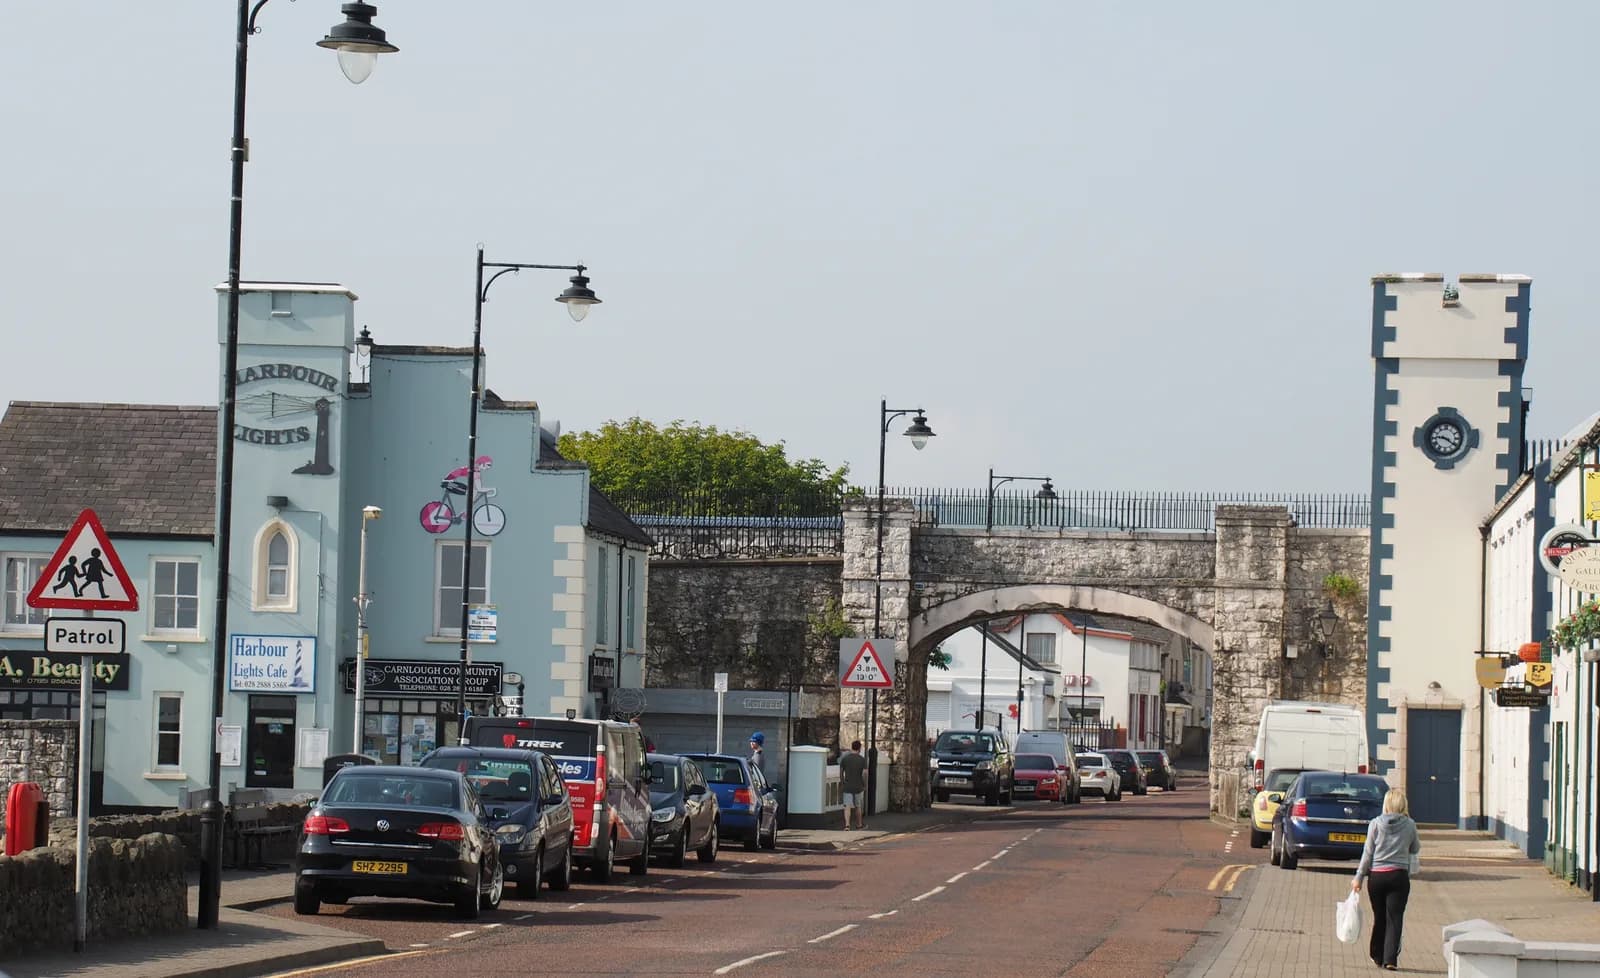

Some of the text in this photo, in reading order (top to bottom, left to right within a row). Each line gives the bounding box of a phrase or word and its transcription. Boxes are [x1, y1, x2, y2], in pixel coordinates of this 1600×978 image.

[55, 628, 114, 644] Patrol
[234, 637, 289, 657] Harbour
[31, 656, 121, 684] Beaty
[234, 662, 288, 679] Lights Cafe
[384, 665, 440, 675] CARNLOUGH
[394, 675, 454, 685] ASSOCIATION
[517, 739, 564, 749] TREK
[356, 861, 404, 873] SHZ 2295
